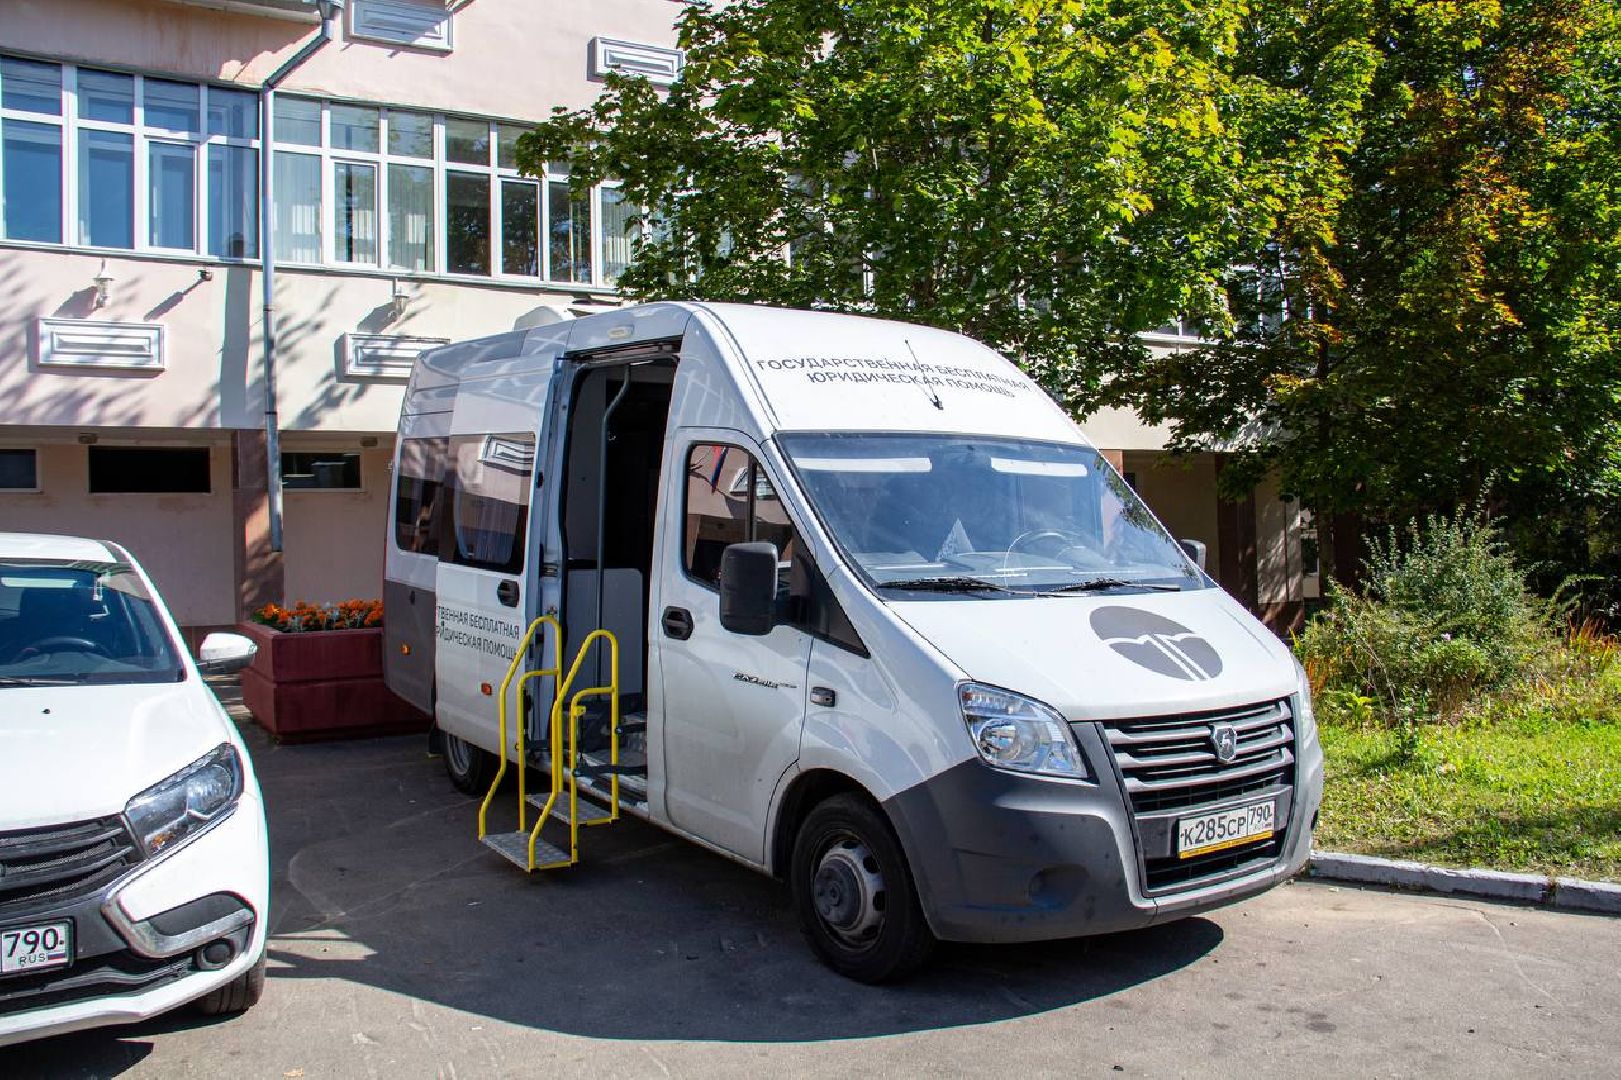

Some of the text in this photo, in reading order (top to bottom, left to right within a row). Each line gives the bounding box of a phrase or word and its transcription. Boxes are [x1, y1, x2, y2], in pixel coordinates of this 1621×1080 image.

[757, 357, 1031, 392] ГОСУДАРСТВЕННАЯ БЕСПЛАТНАЯ
[806, 371, 1016, 398] ЮРИДИЧЕСКАЯ ПОМОЩЬ
[469, 614, 520, 640] БЕСПЛАТНАЯ
[1184, 804, 1271, 847] К285СР 790
[4, 928, 59, 958] 790
[19, 952, 46, 965] RUS
